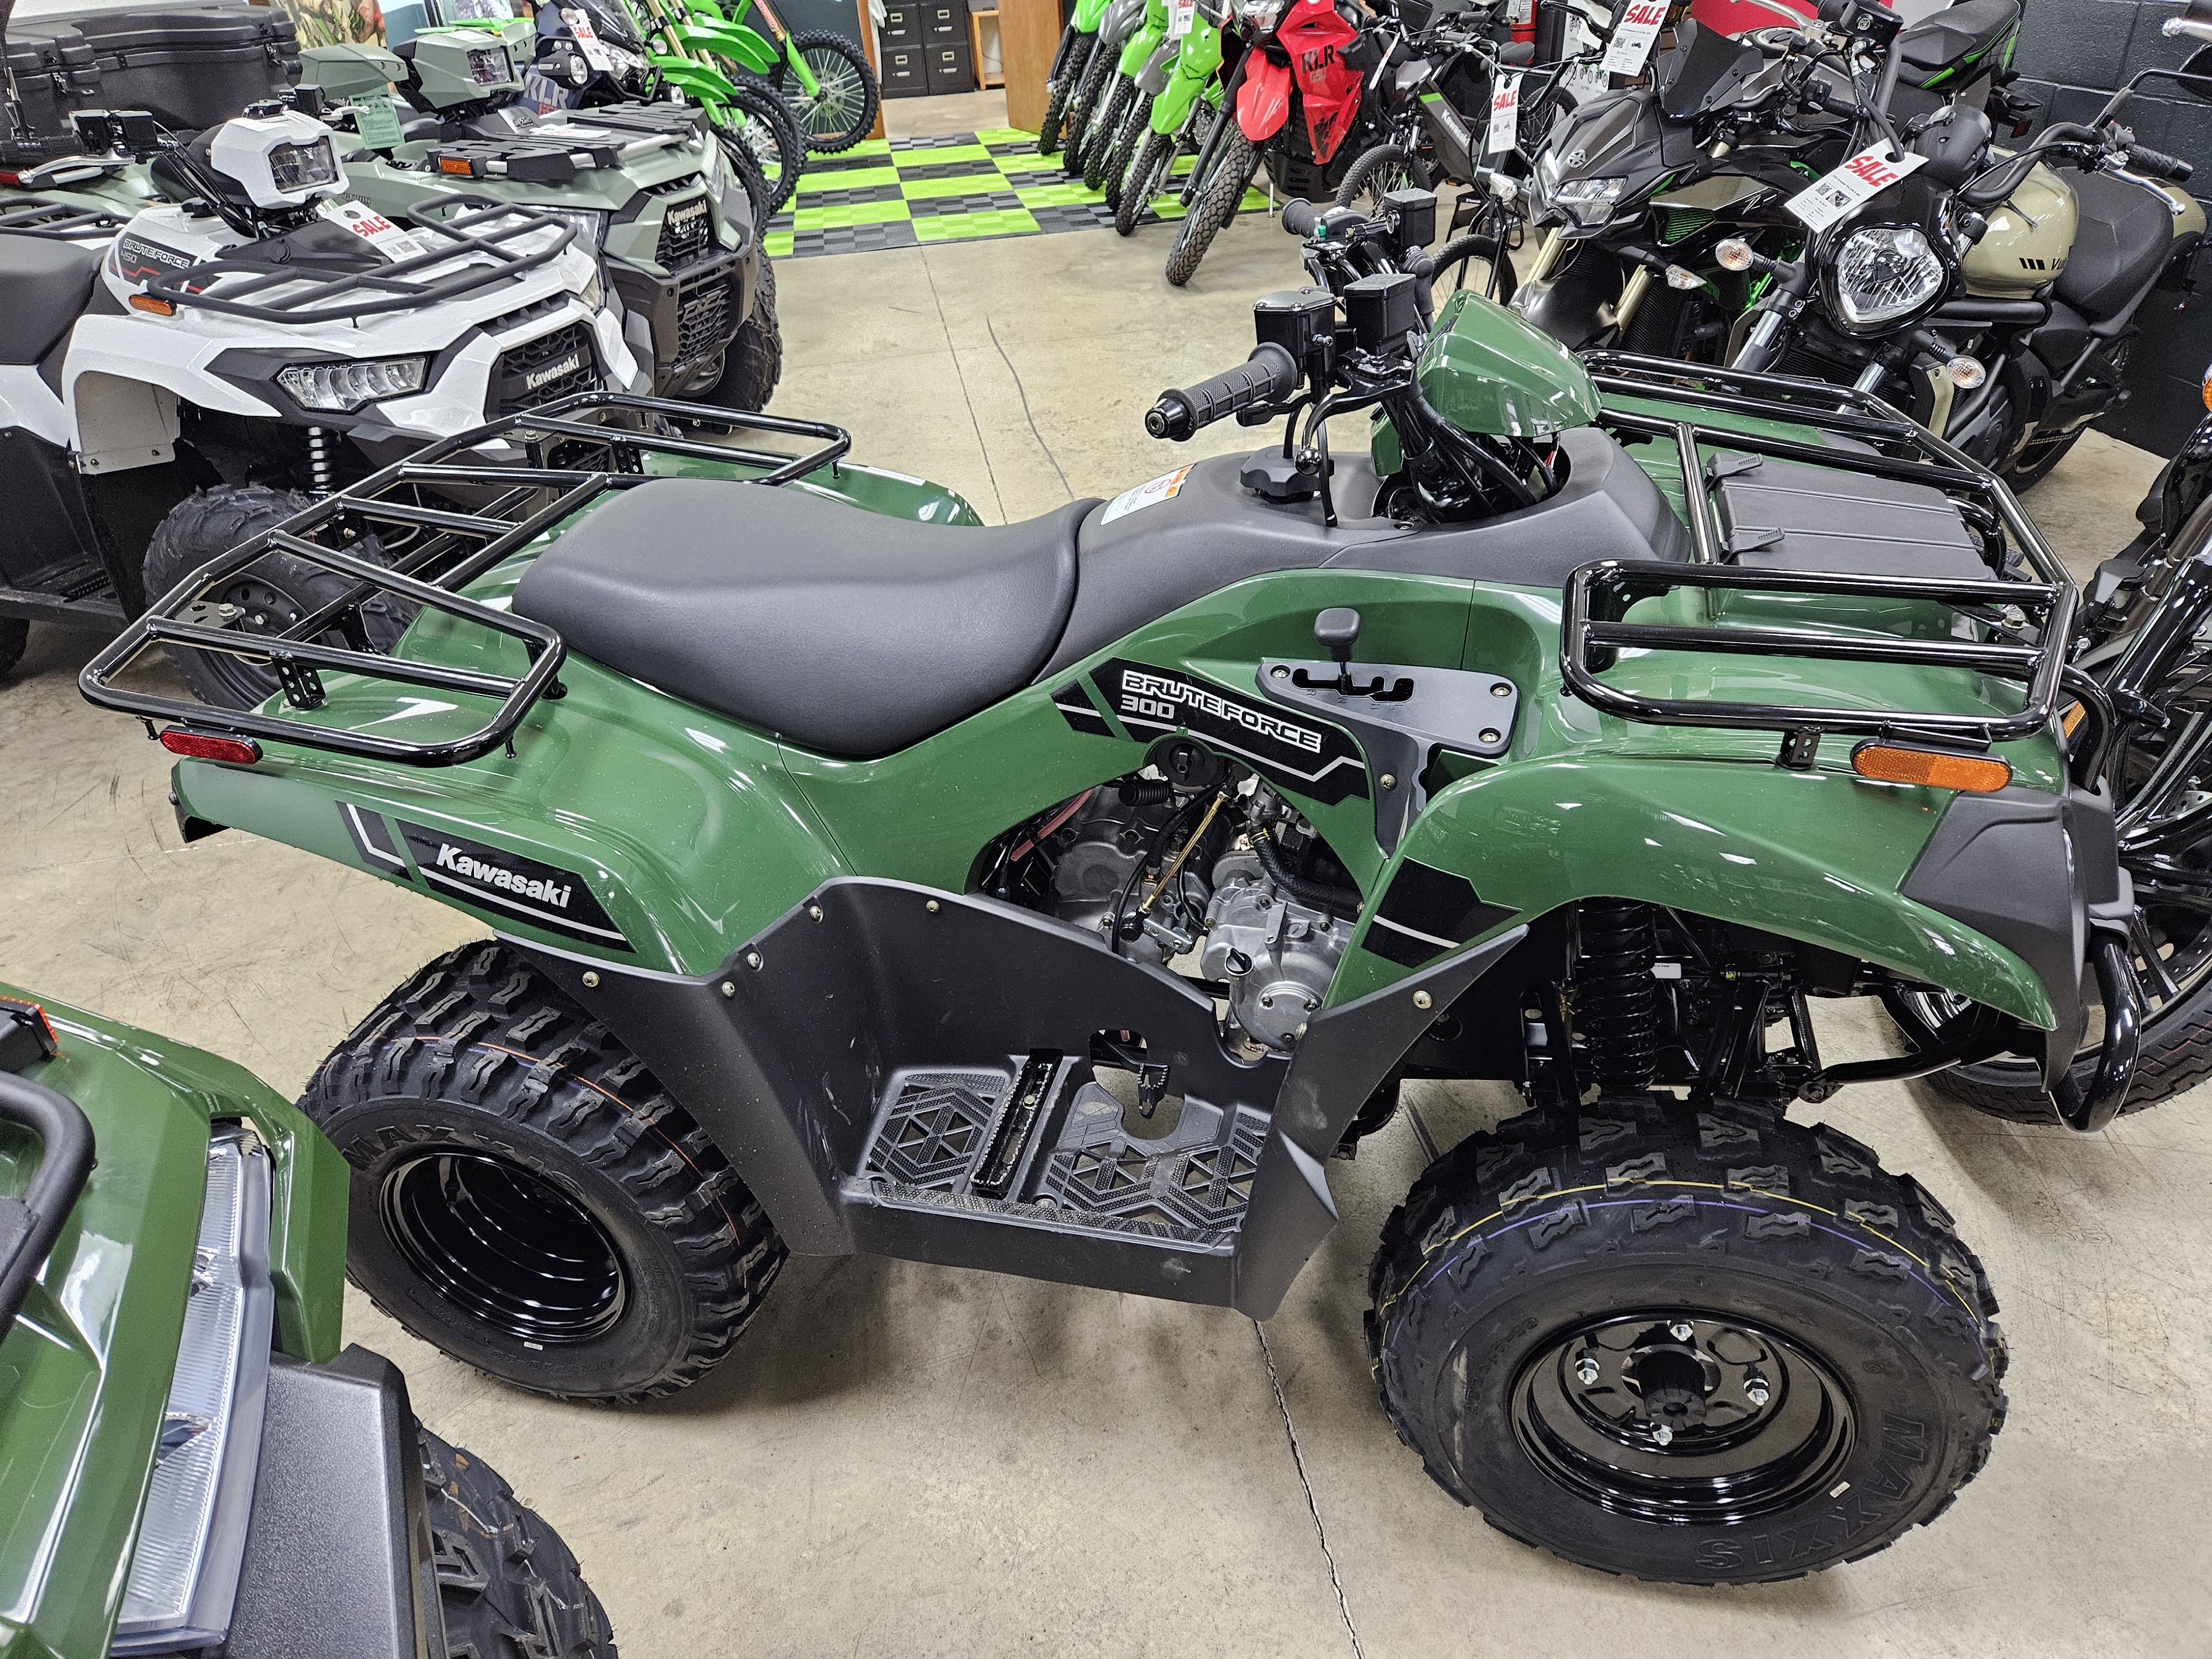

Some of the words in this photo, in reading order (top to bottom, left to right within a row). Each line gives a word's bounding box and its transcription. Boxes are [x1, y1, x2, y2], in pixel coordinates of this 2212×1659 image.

[1624, 4, 1666, 25] SALE
[574, 27, 593, 38] SALE
[1302, 44, 1335, 74] KLR
[523, 73, 567, 110] KLR
[1494, 90, 1517, 111] SALE
[1441, 109, 1471, 147] Kawasaki
[1845, 155, 1898, 187] SALE
[667, 199, 707, 225] Kawasaki
[353, 216, 392, 237] SALE
[121, 251, 138, 264] 450
[526, 353, 580, 389] Kawasaki
[1120, 694, 1175, 719] 300
[436, 843, 572, 907] Kawasaki
[1695, 1411, 1925, 1569] MAXXIS
